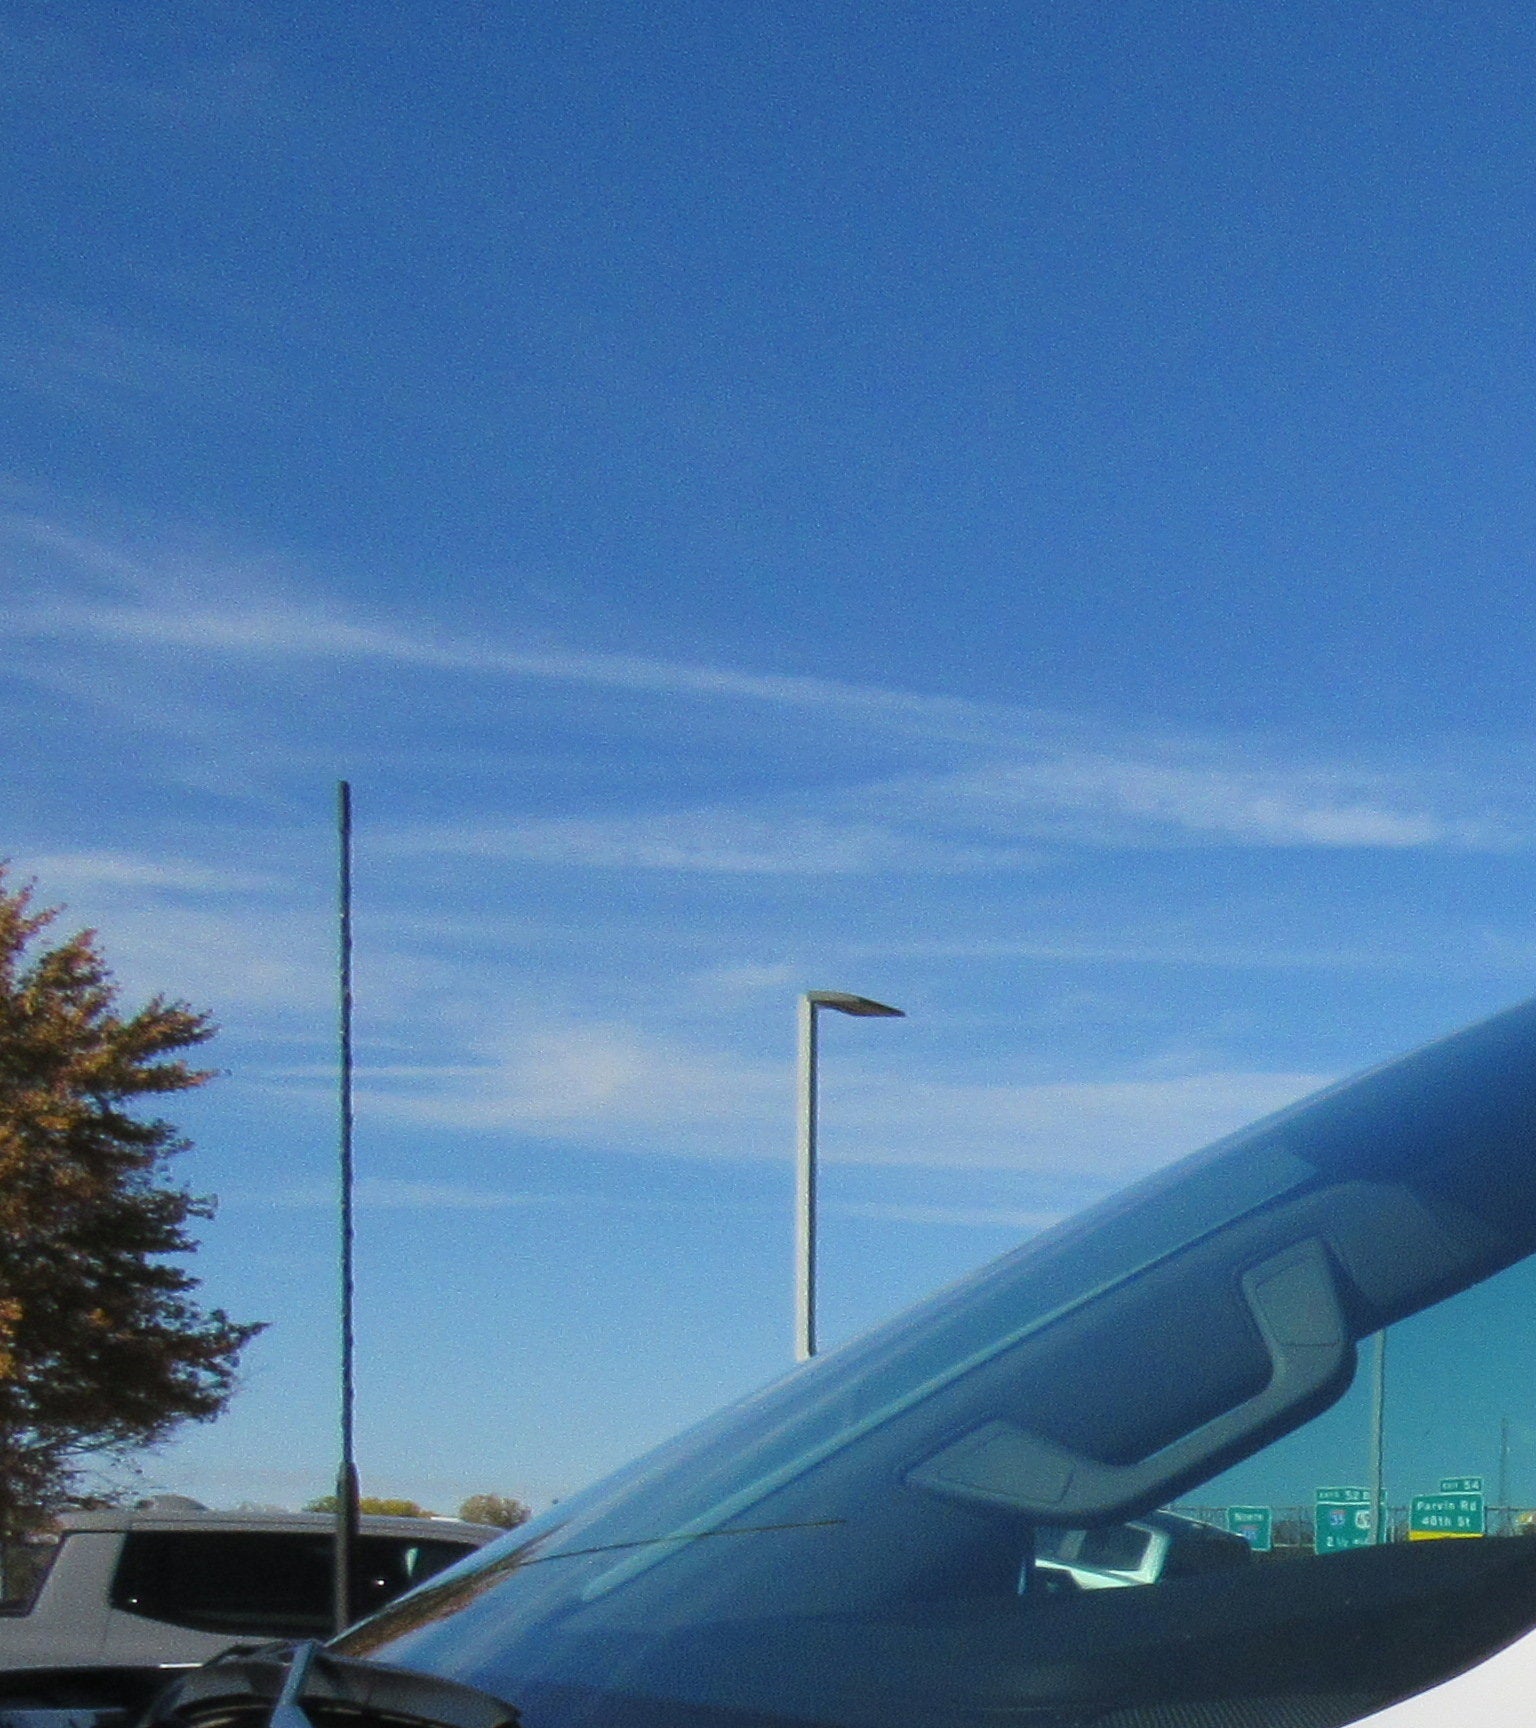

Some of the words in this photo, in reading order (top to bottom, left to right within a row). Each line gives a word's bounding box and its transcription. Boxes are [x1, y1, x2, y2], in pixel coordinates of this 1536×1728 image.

[1464, 1480, 1480, 1490] 54
[1417, 1501, 1456, 1512] Parvin
[1461, 1500, 1477, 1511] Rd
[1458, 1516, 1471, 1527] St
